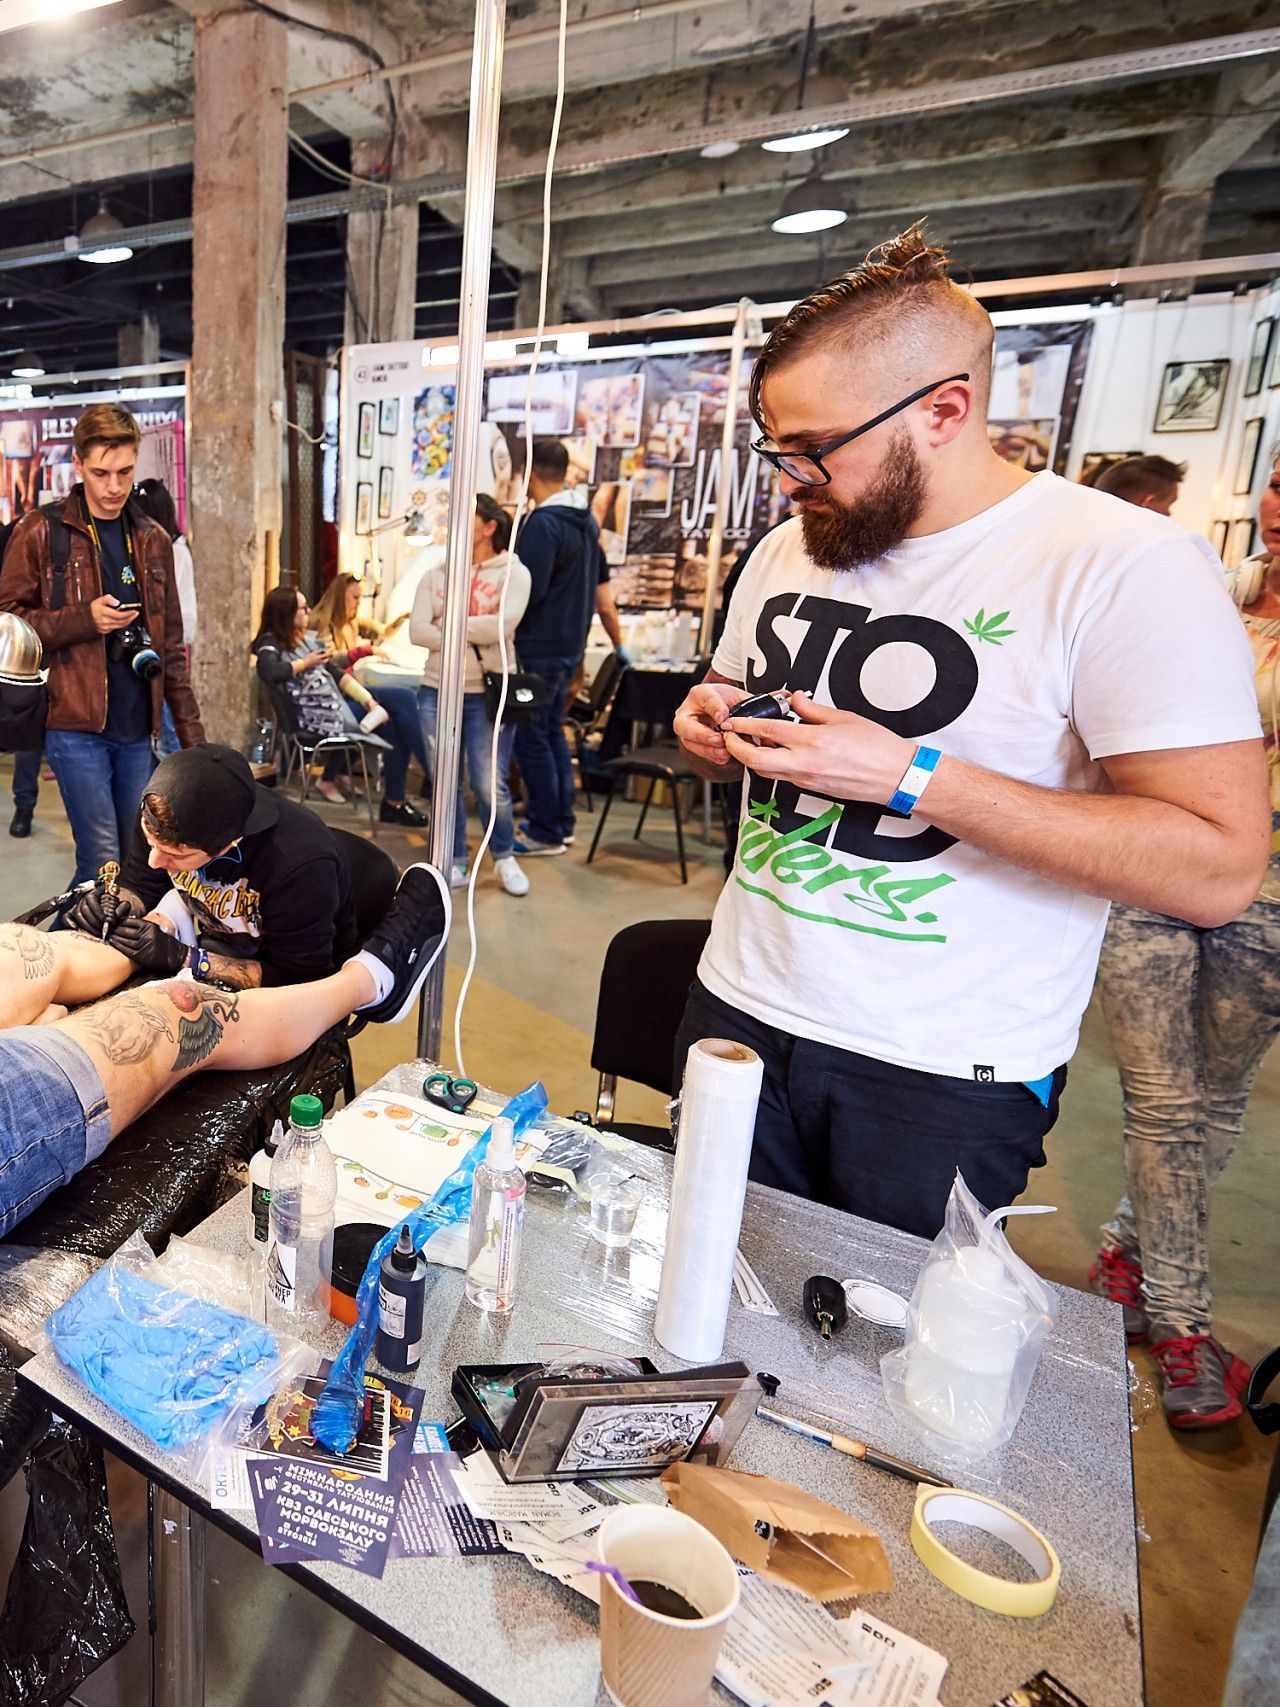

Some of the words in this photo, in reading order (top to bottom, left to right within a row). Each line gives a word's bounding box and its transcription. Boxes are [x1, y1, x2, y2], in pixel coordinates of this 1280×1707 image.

[681, 448, 759, 529] JAM
[681, 528, 752, 540] TATOO
[281, 1481, 324, 1506] 29-31
[326, 1497, 389, 1529] ЛИПНЯ
[304, 1504, 387, 1543] ОДЕСЬКОГО
[280, 1507, 374, 1549] МОРВОКЗАЛУ
